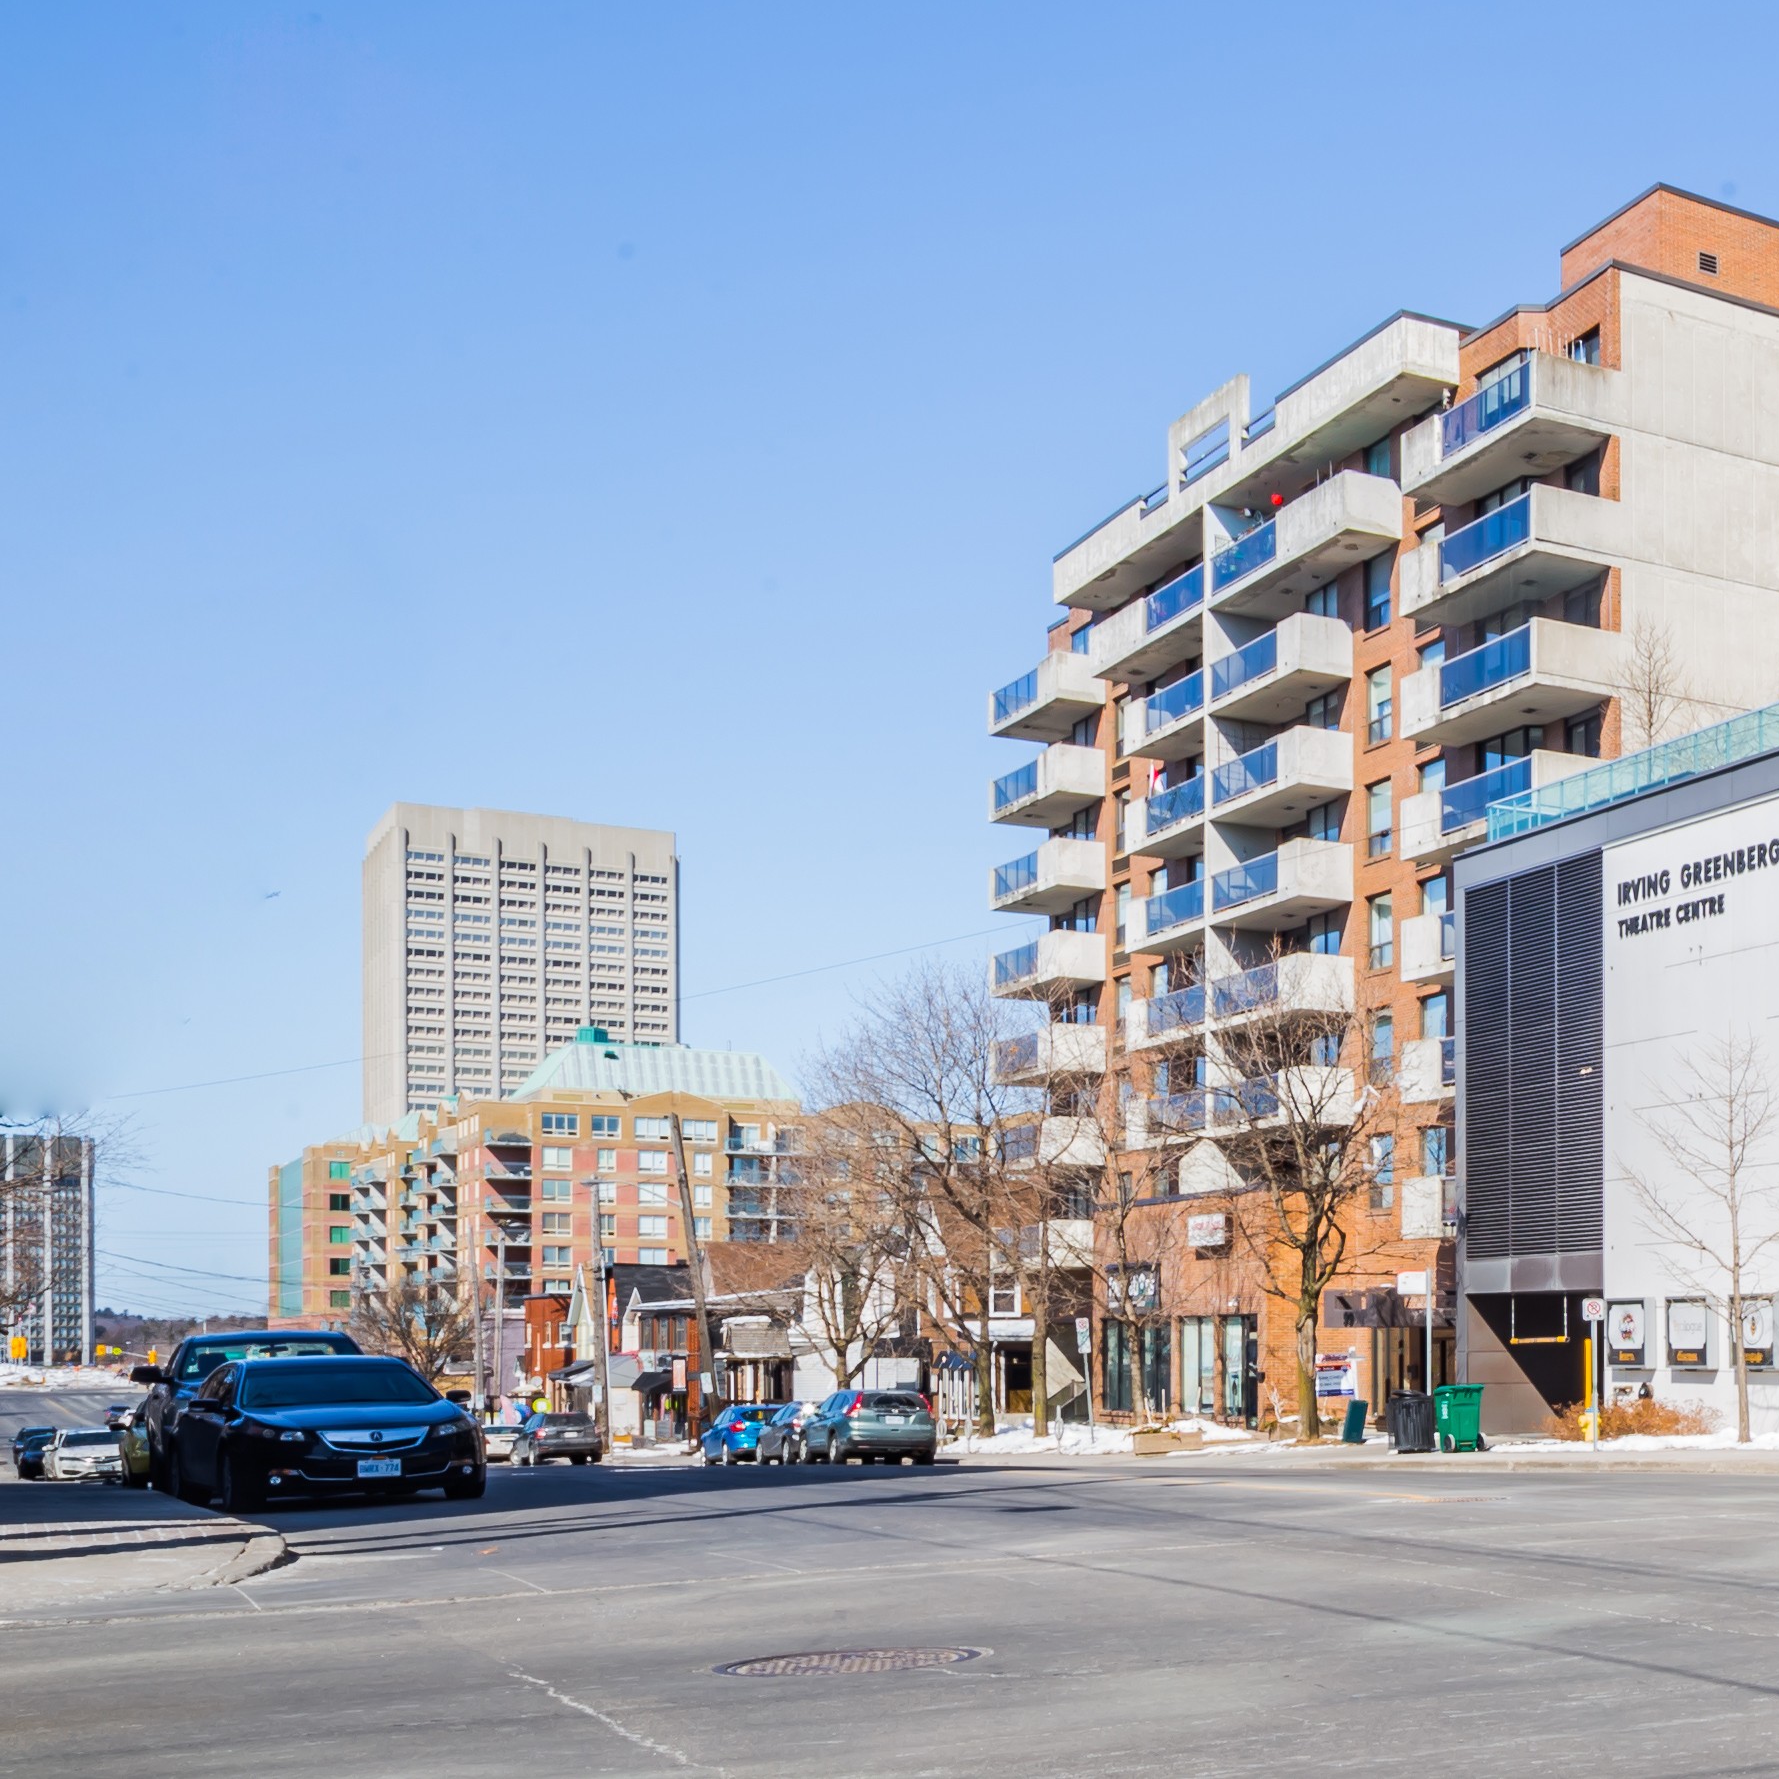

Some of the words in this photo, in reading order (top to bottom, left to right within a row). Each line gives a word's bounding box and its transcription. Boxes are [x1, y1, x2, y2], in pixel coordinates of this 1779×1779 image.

[1617, 869, 1671, 907] IRVING
[1617, 907, 1671, 940] THEATRE
[1676, 893, 1726, 925] CENTRE
